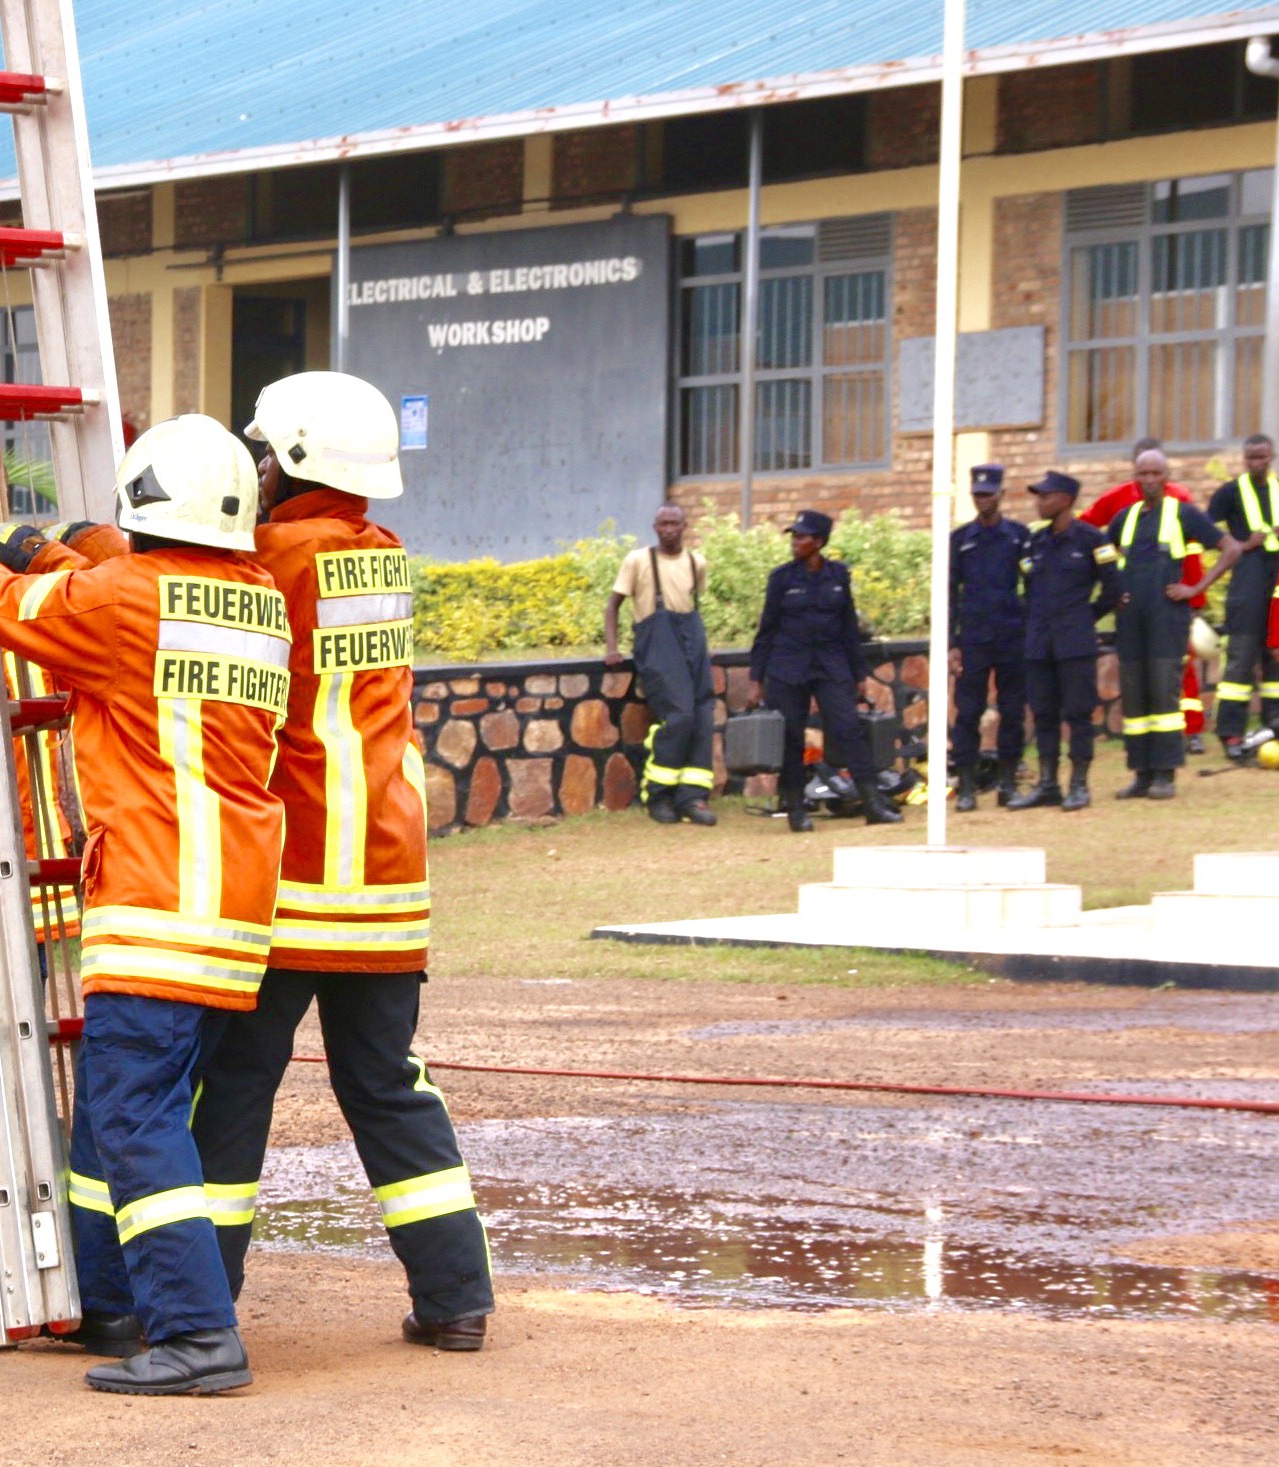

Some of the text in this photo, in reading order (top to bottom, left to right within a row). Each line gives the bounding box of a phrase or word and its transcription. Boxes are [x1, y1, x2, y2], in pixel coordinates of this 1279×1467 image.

[347, 256, 639, 305] LECTRICAL & ELECTRONICS
[428, 317, 550, 348] WORKSHOP
[323, 556, 368, 591] FIRE
[162, 659, 220, 694] FIRE
